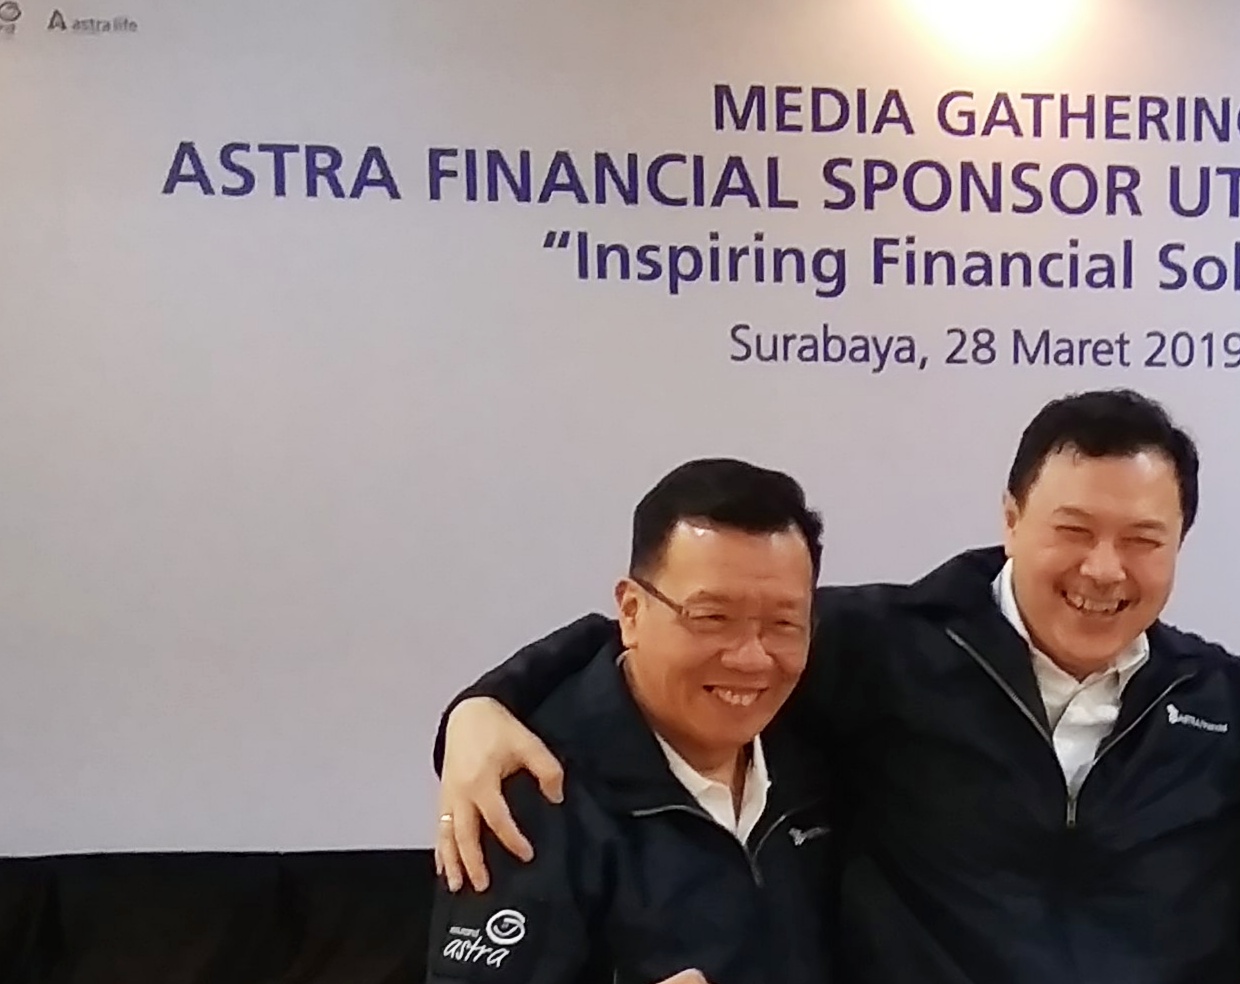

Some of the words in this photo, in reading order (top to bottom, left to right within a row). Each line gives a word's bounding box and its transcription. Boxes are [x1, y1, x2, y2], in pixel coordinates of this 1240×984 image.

[72, 18, 111, 33] astra
[713, 83, 916, 136] MEDIA
[161, 140, 402, 201] ASTRA
[428, 147, 799, 210] FINANCIAL
[822, 156, 1143, 217] SPONSOR
[542, 229, 847, 299] “Inspiring
[872, 235, 1133, 290] Financial
[730, 322, 929, 374] Surabaya,
[944, 327, 997, 366] 28
[1012, 328, 1131, 368] Maret
[443, 936, 510, 967] astra
